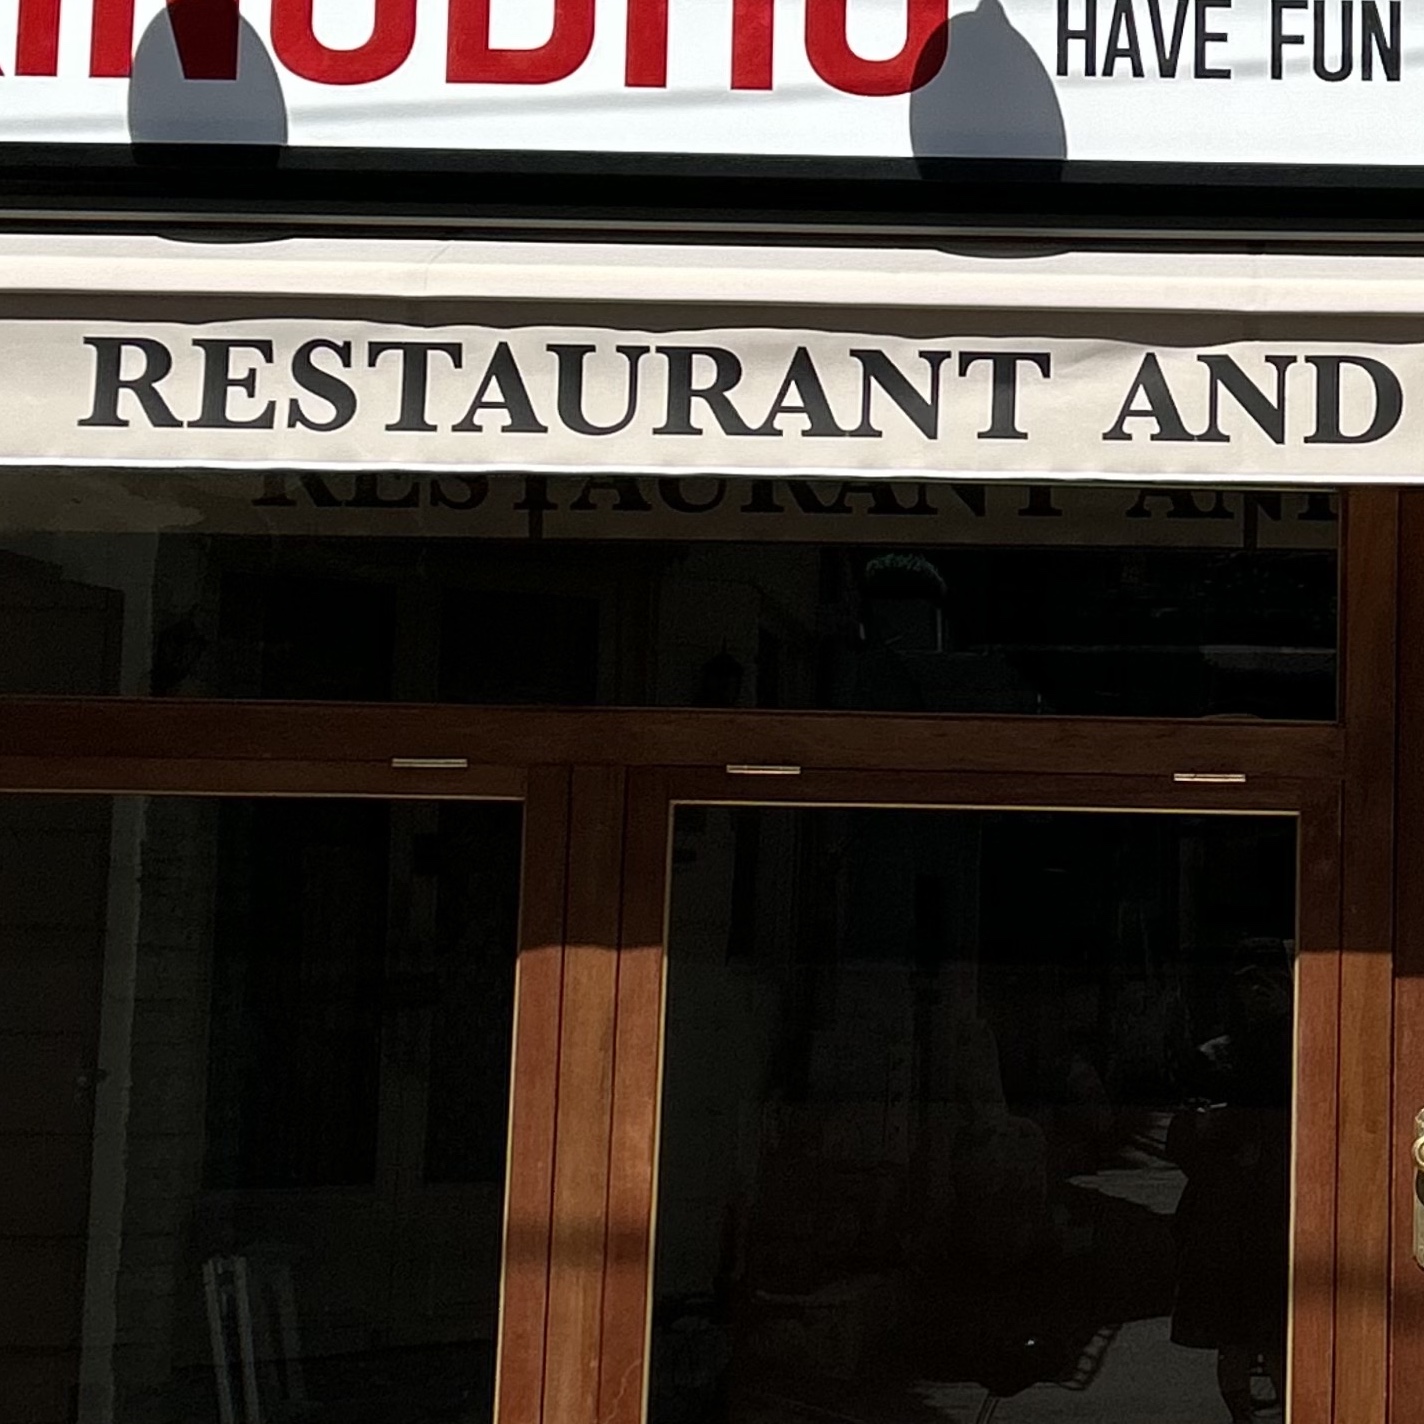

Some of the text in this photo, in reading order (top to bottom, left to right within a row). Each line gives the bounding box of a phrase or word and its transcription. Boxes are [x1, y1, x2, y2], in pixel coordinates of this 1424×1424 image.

[1056, 0, 1232, 80] HAVE
[1267, 0, 1401, 82] FUN
[77, 334, 1051, 441] RESTAURANT
[1103, 351, 1404, 446] AND
